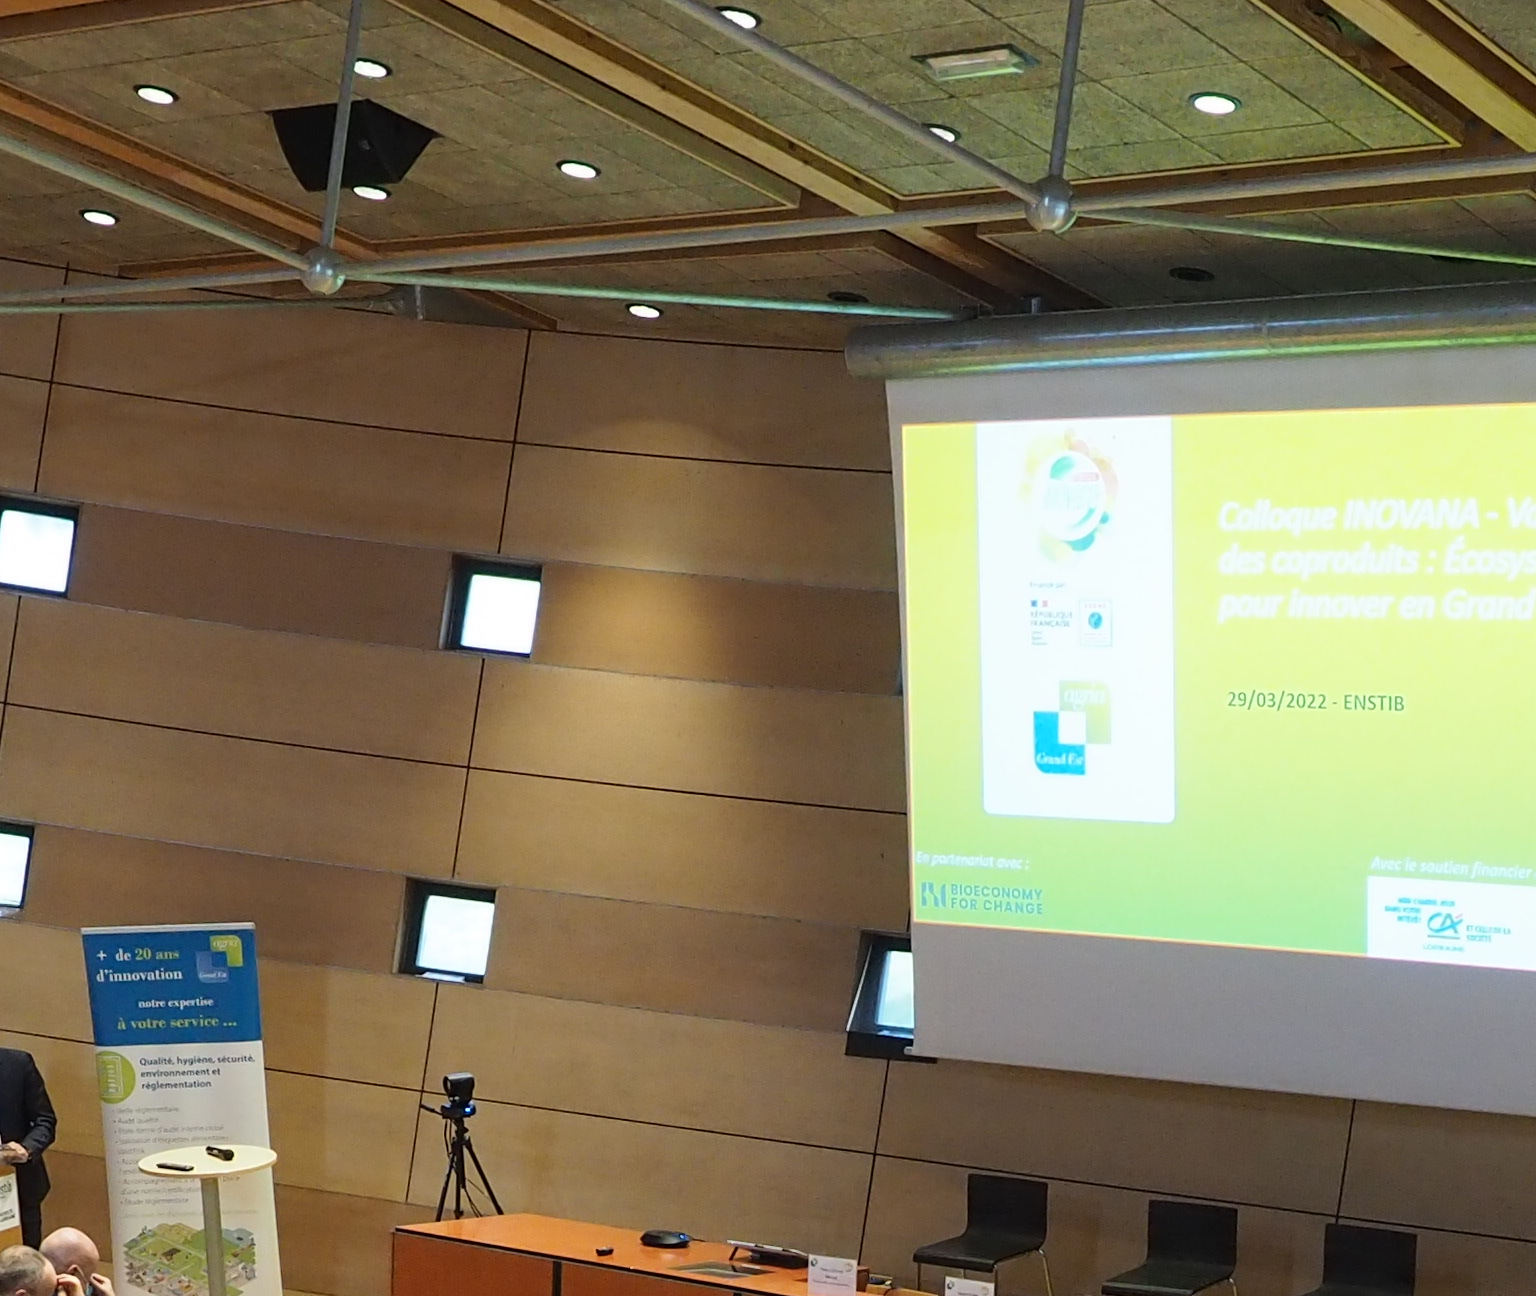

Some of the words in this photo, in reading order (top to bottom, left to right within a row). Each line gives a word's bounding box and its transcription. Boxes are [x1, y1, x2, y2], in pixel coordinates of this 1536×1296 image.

[1219, 499, 1337, 537] Colloque
[1343, 497, 1480, 530] INOVANA
[1218, 542, 1265, 574] des
[1272, 541, 1419, 581] coproduits
[1217, 595, 1284, 624] pour
[1288, 588, 1394, 619] innover
[1399, 595, 1435, 619] en
[1442, 586, 1536, 620] Grand
[1228, 690, 1327, 711] 29/03/2022
[1344, 694, 1405, 711] ENSTIB
[916, 851, 929, 864] En
[931, 853, 994, 867] partenariat
[997, 858, 1023, 869] avec
[1370, 856, 1401, 871] Avec
[1405, 857, 1416, 871] le
[1420, 859, 1468, 875] soutien
[1471, 861, 1532, 879] financier
[951, 884, 1043, 900] BIOECONOMY
[951, 898, 977, 910] FOR
[983, 900, 1043, 915] CHANGE
[115, 948, 132, 961] de
[135, 948, 152, 961] 20
[155, 949, 180, 960] ans
[138, 999, 165, 1009] notre
[168, 997, 214, 1010] expertise
[117, 1018, 126, 1030] à
[131, 1019, 166, 1029] votre
[170, 1016, 219, 1028] service
[139, 1056, 175, 1066] Qualité,
[177, 1054, 216, 1067] hygiène,
[217, 1053, 255, 1065] sécurité,
[140, 1068, 210, 1078] environnement
[212, 1067, 221, 1076] et
[142, 1080, 212, 1090] réglementation
